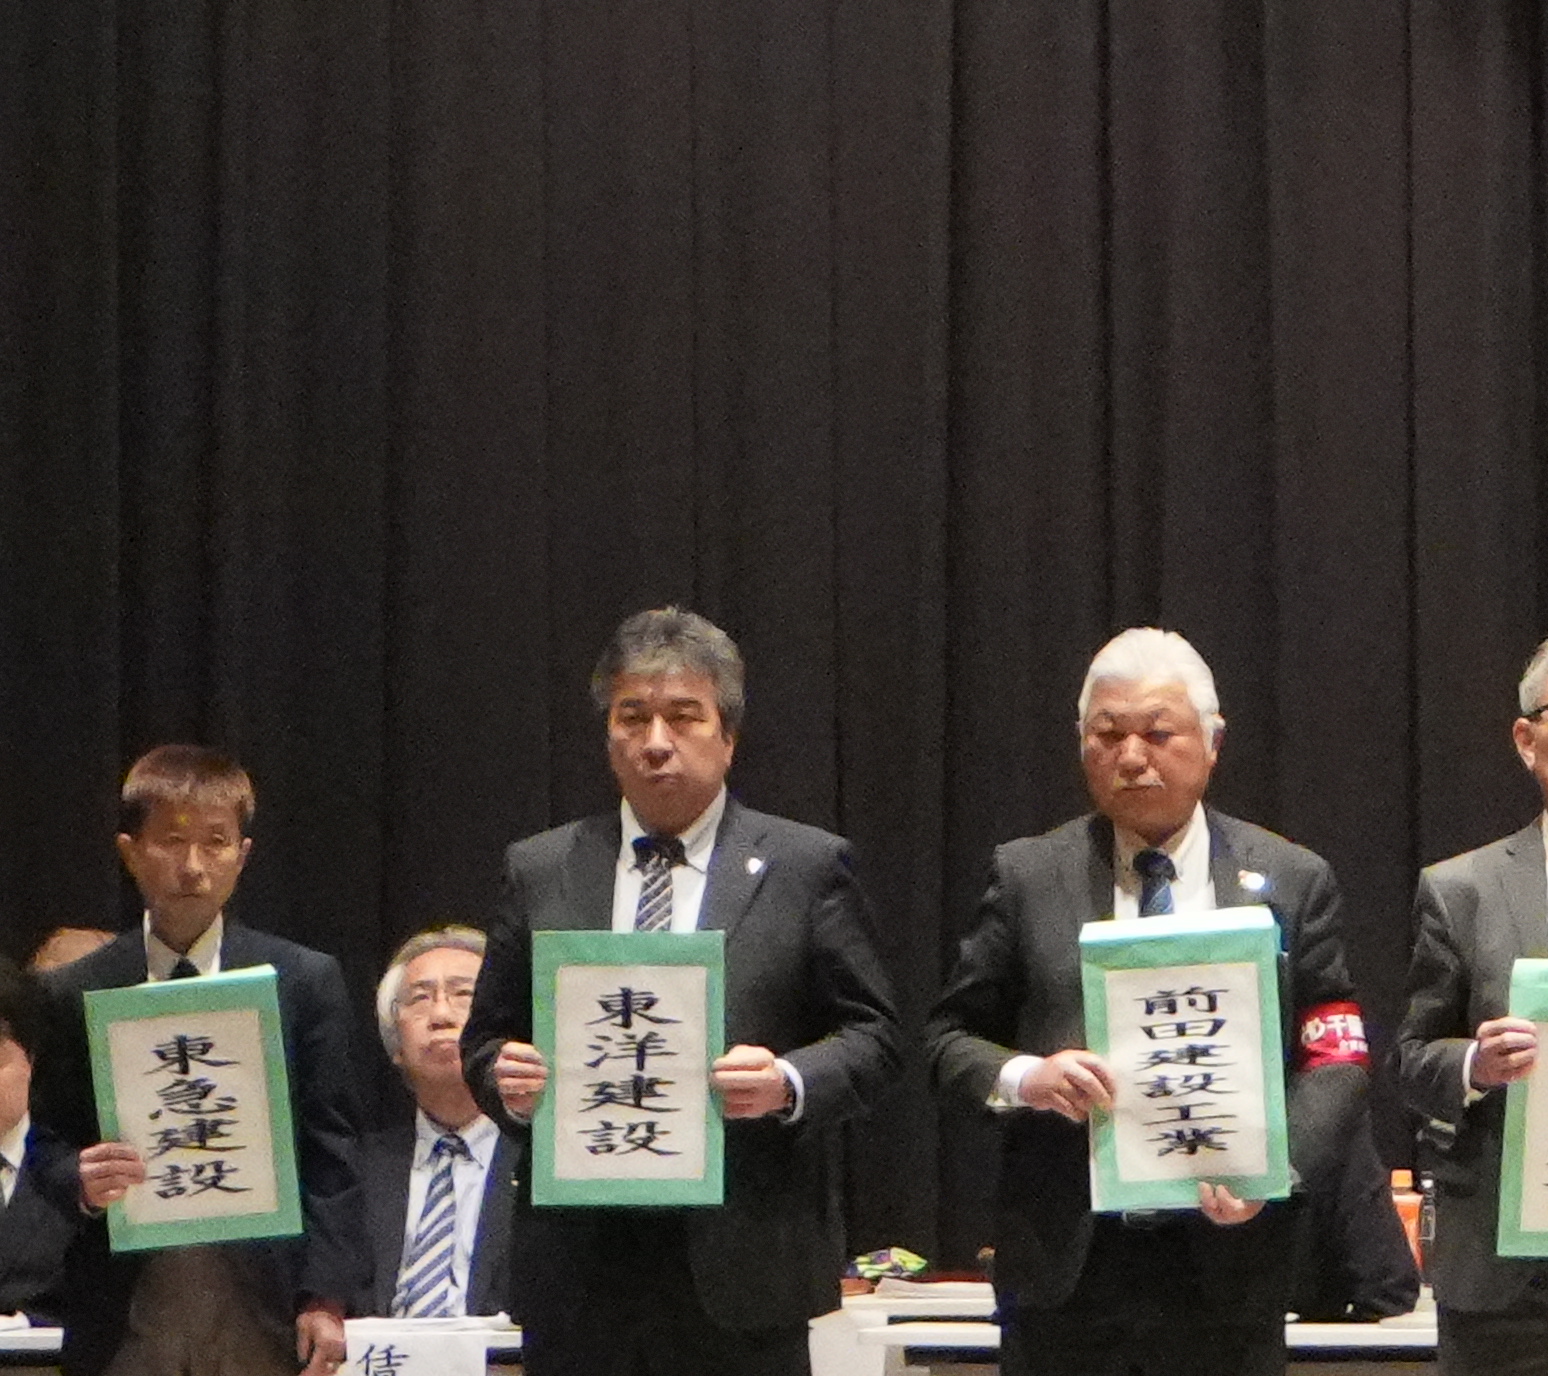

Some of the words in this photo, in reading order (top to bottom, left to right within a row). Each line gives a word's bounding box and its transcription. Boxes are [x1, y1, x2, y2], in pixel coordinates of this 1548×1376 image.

[147, 1033, 254, 1203] 東急建設
[578, 986, 682, 1158] 東洋建設
[1134, 985, 1239, 1158] 前田建設工業
